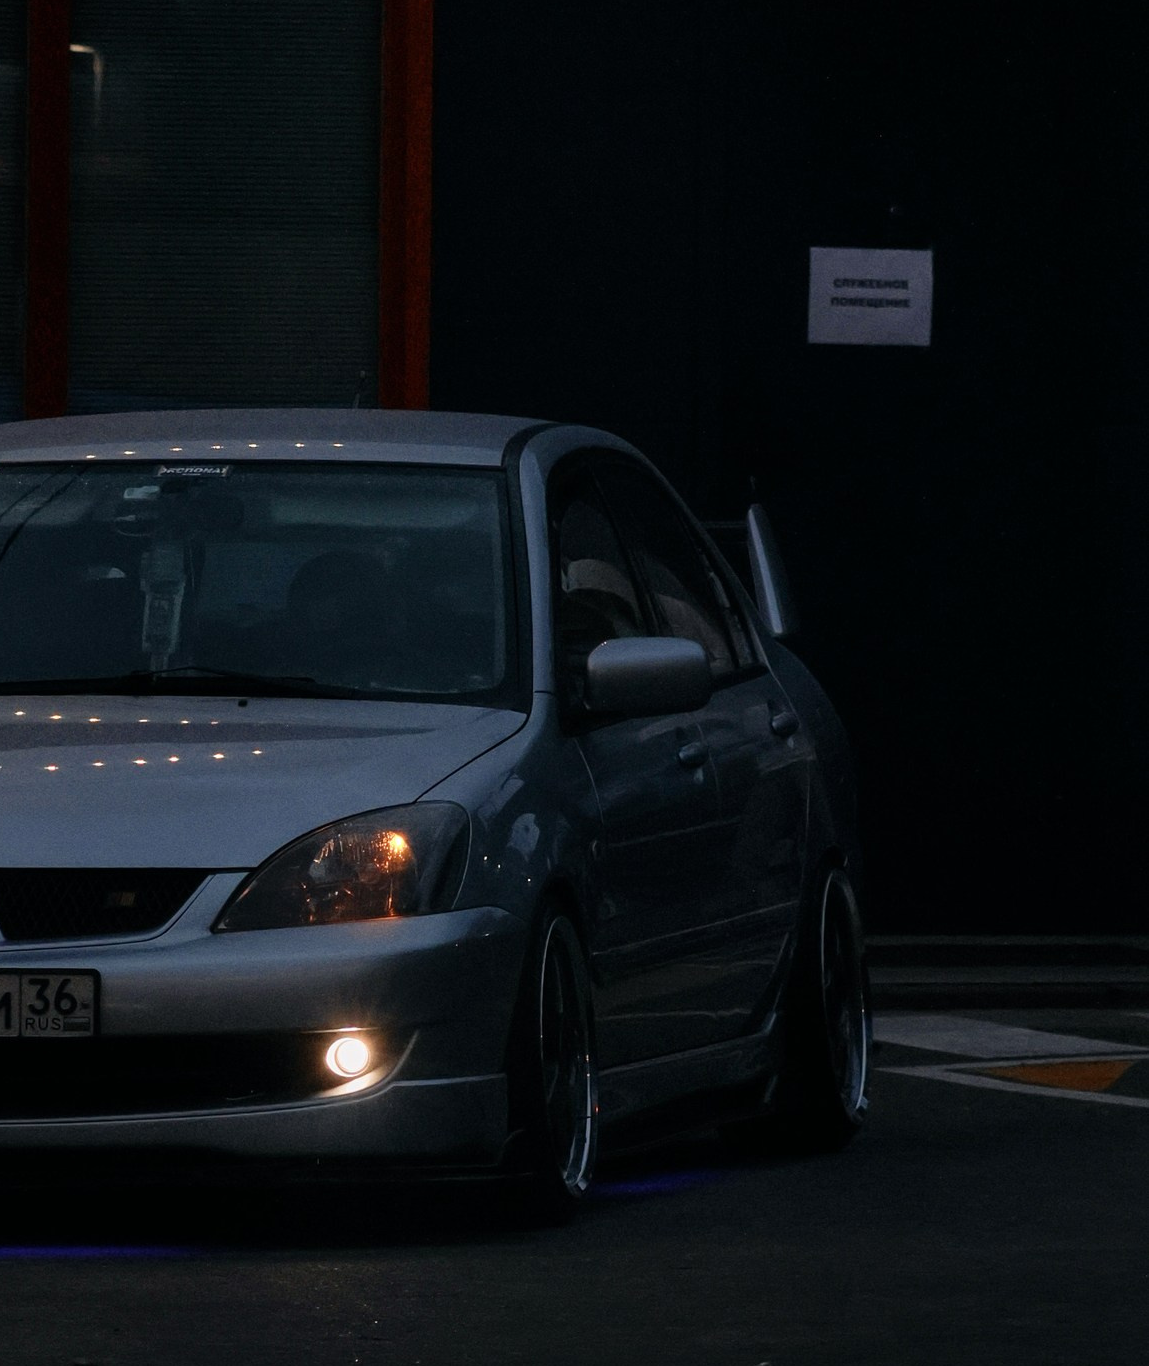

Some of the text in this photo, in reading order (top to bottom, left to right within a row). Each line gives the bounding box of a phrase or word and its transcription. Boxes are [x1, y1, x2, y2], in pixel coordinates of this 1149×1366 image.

[830, 297, 910, 308] ПОМЕЩЕНИЕ
[27, 977, 78, 1016] 36
[25, 1017, 62, 1031] RUS
